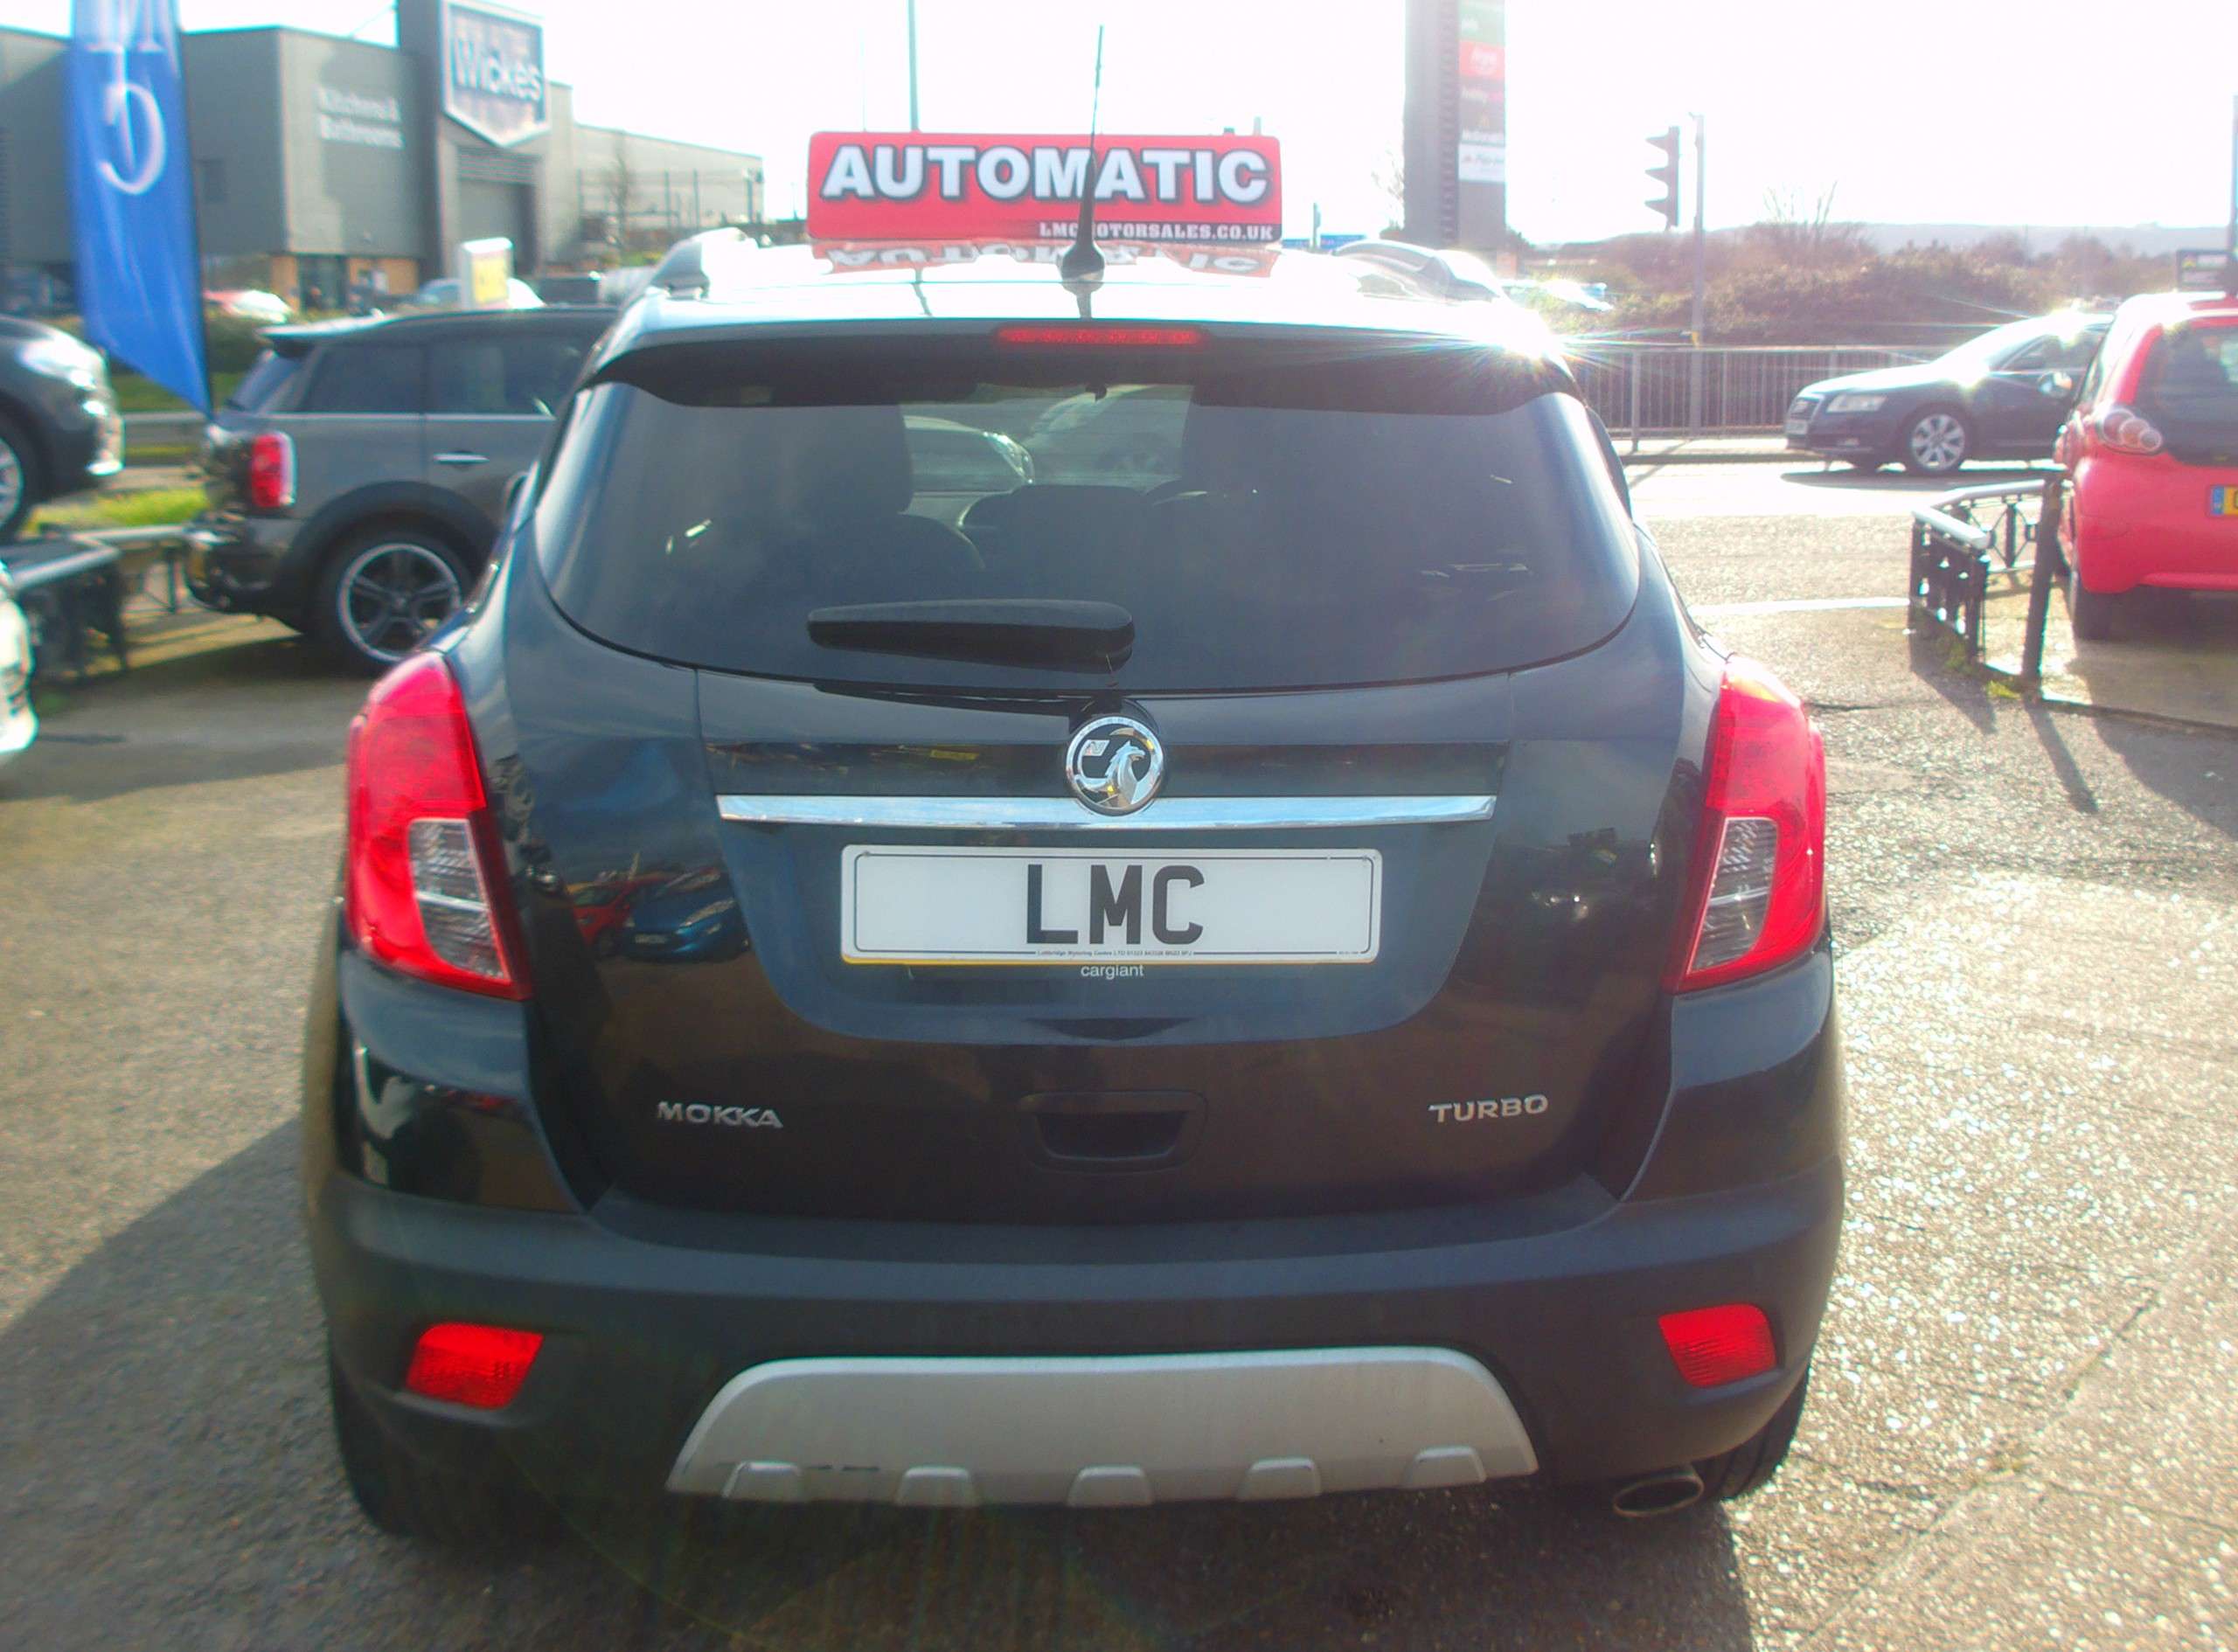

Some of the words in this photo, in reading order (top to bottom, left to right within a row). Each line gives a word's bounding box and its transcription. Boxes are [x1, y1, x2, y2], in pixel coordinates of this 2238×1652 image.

[821, 143, 1268, 204] AUTOMATIC
[1039, 222, 1273, 240] LMCOTORSALES.CO.UK
[1026, 863, 1205, 945] LMC
[1081, 964, 1144, 980] cargiant
[657, 1100, 784, 1128] MOKKA
[1428, 1093, 1549, 1123] TURBO
